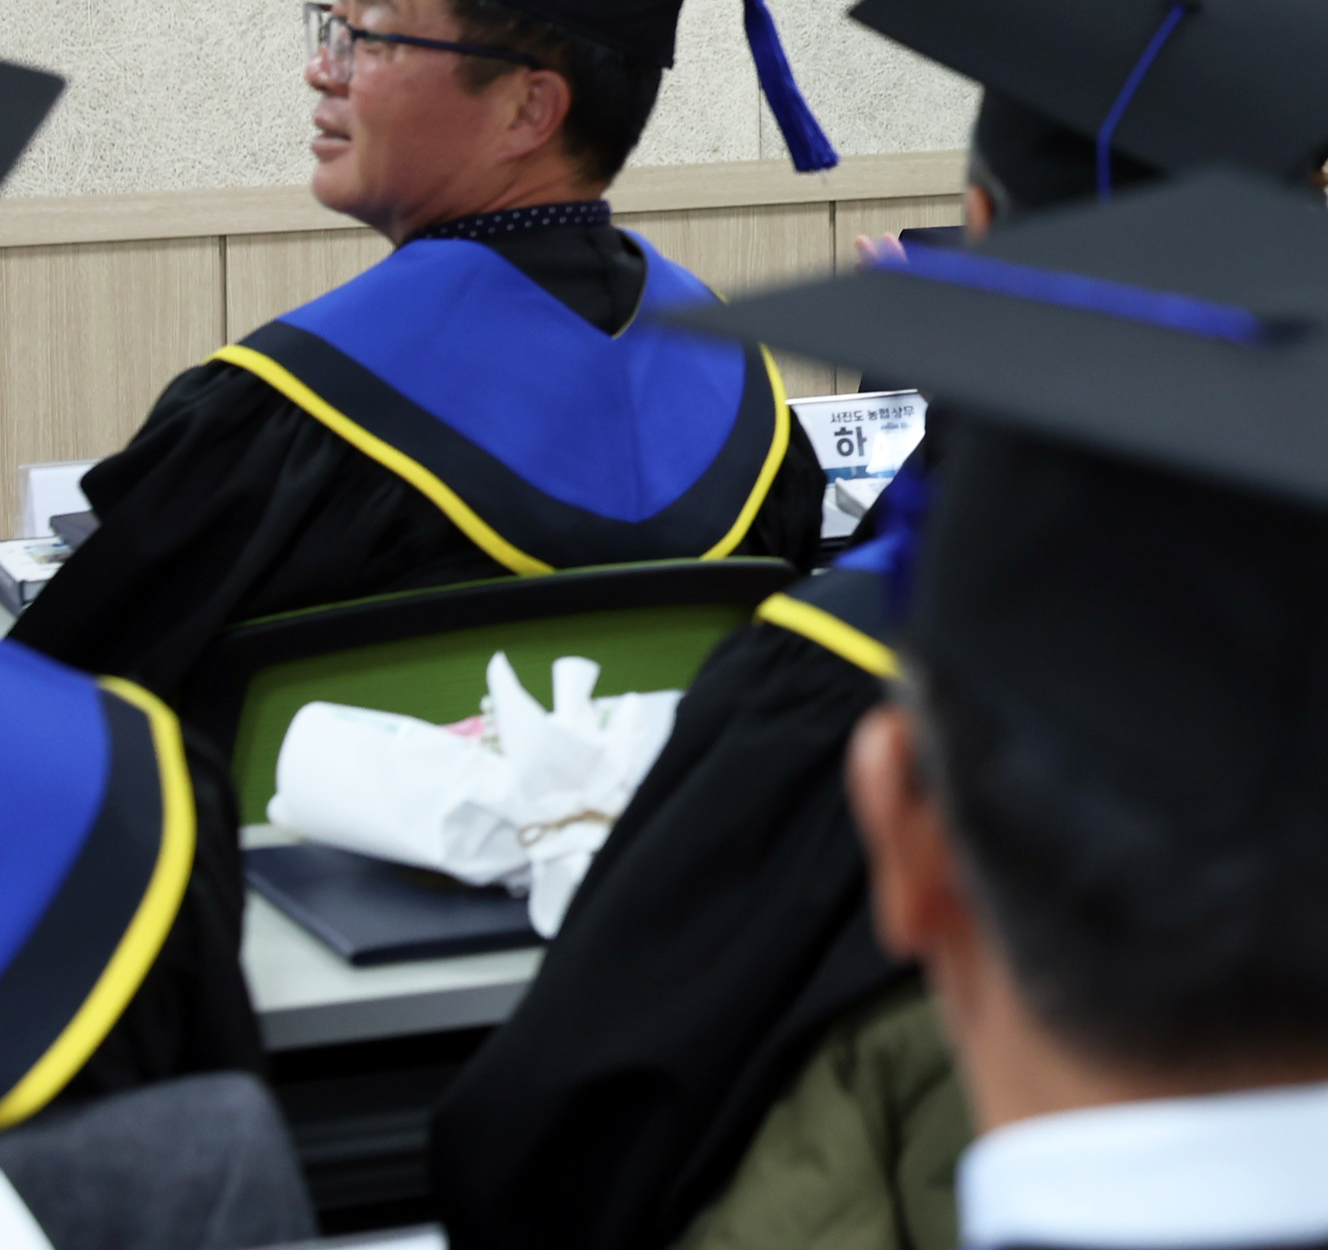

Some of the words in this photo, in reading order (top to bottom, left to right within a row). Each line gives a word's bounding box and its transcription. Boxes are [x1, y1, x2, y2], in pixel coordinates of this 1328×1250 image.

[831, 410, 865, 424] 서진도
[867, 407, 890, 421] 농협
[892, 405, 915, 419] 상무
[834, 426, 867, 457] 하
